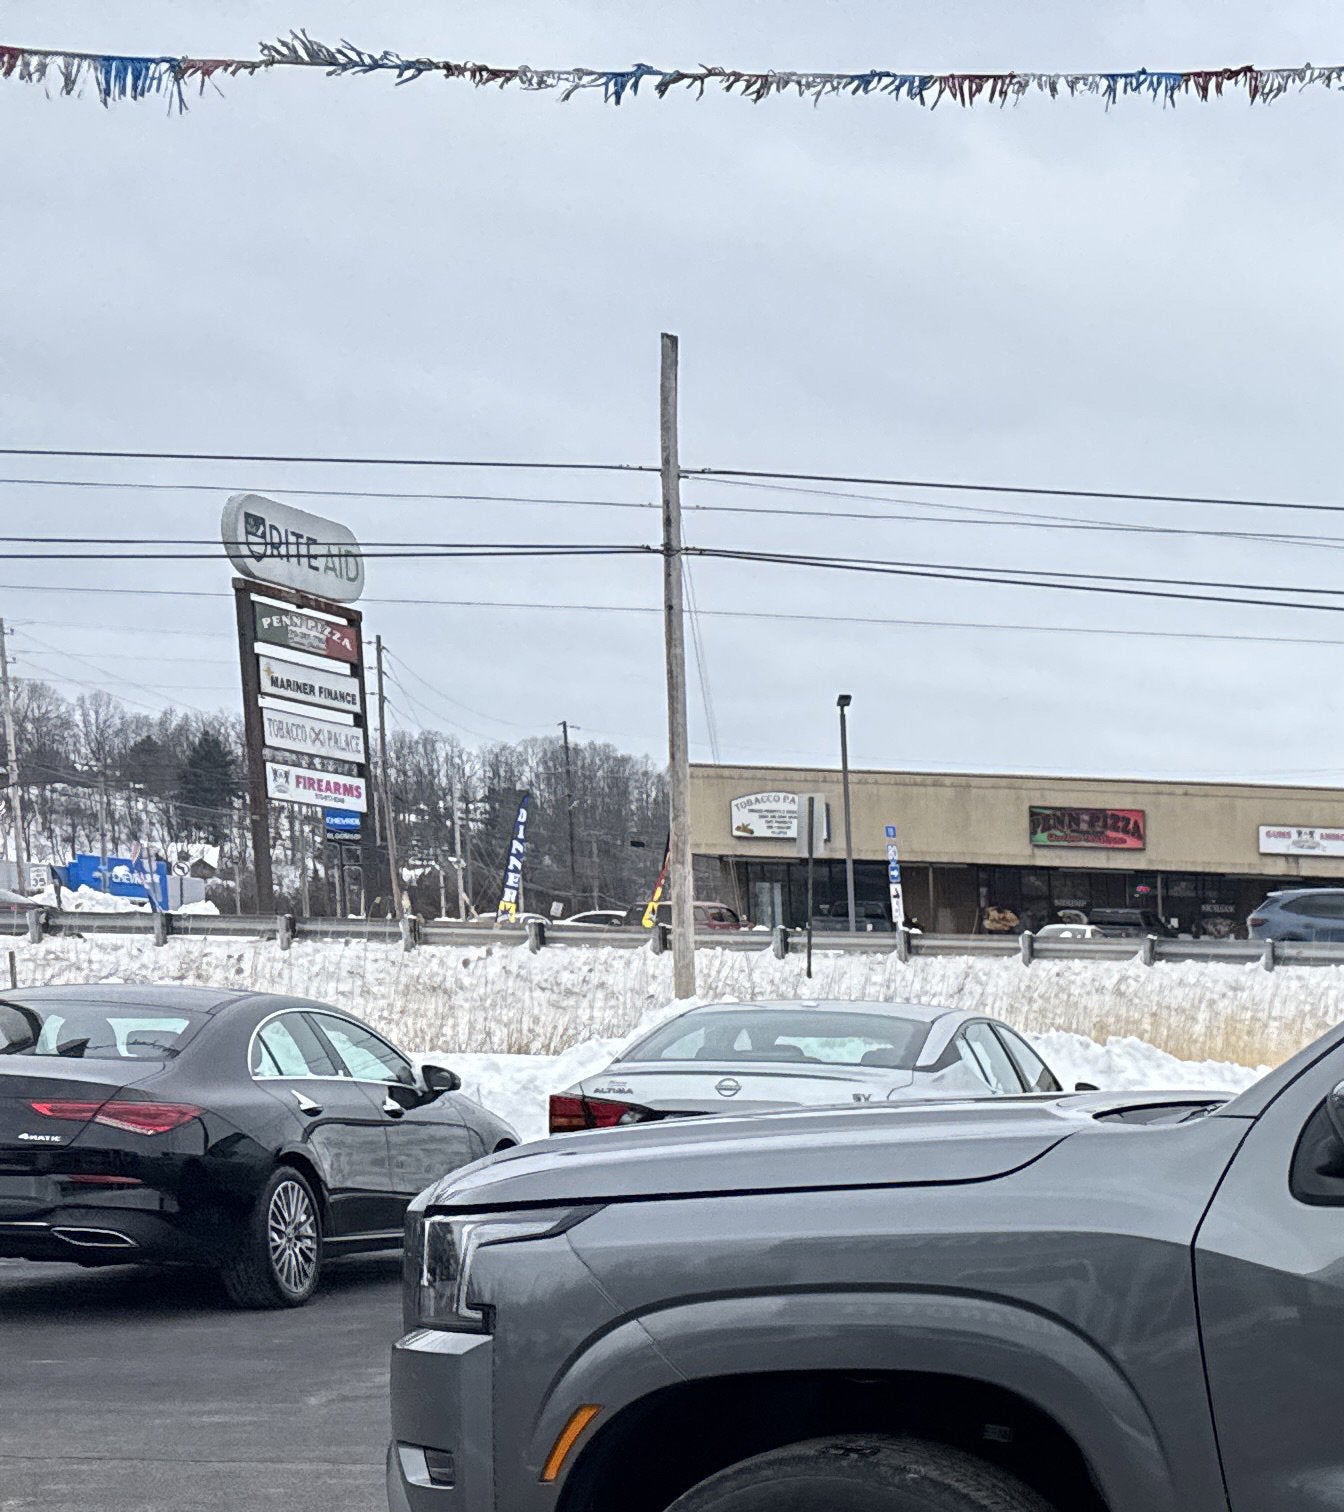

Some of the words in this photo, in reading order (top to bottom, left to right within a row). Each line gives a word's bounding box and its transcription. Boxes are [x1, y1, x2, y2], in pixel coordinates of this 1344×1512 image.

[269, 524, 319, 572] RITE
[324, 546, 359, 582] AID
[262, 615, 301, 628] PENN
[307, 620, 352, 651] PIZZA
[270, 675, 316, 696] MARINER
[319, 686, 357, 705] FINANCE
[267, 717, 307, 743] TOBACCO
[327, 730, 361, 754] PALACE
[295, 775, 362, 799] FIREARMS
[734, 795, 780, 812] TOBACCO
[502, 808, 528, 903] DINNER
[32, 878, 46, 887] 35
[18, 1133, 61, 1142] 4MATIC
